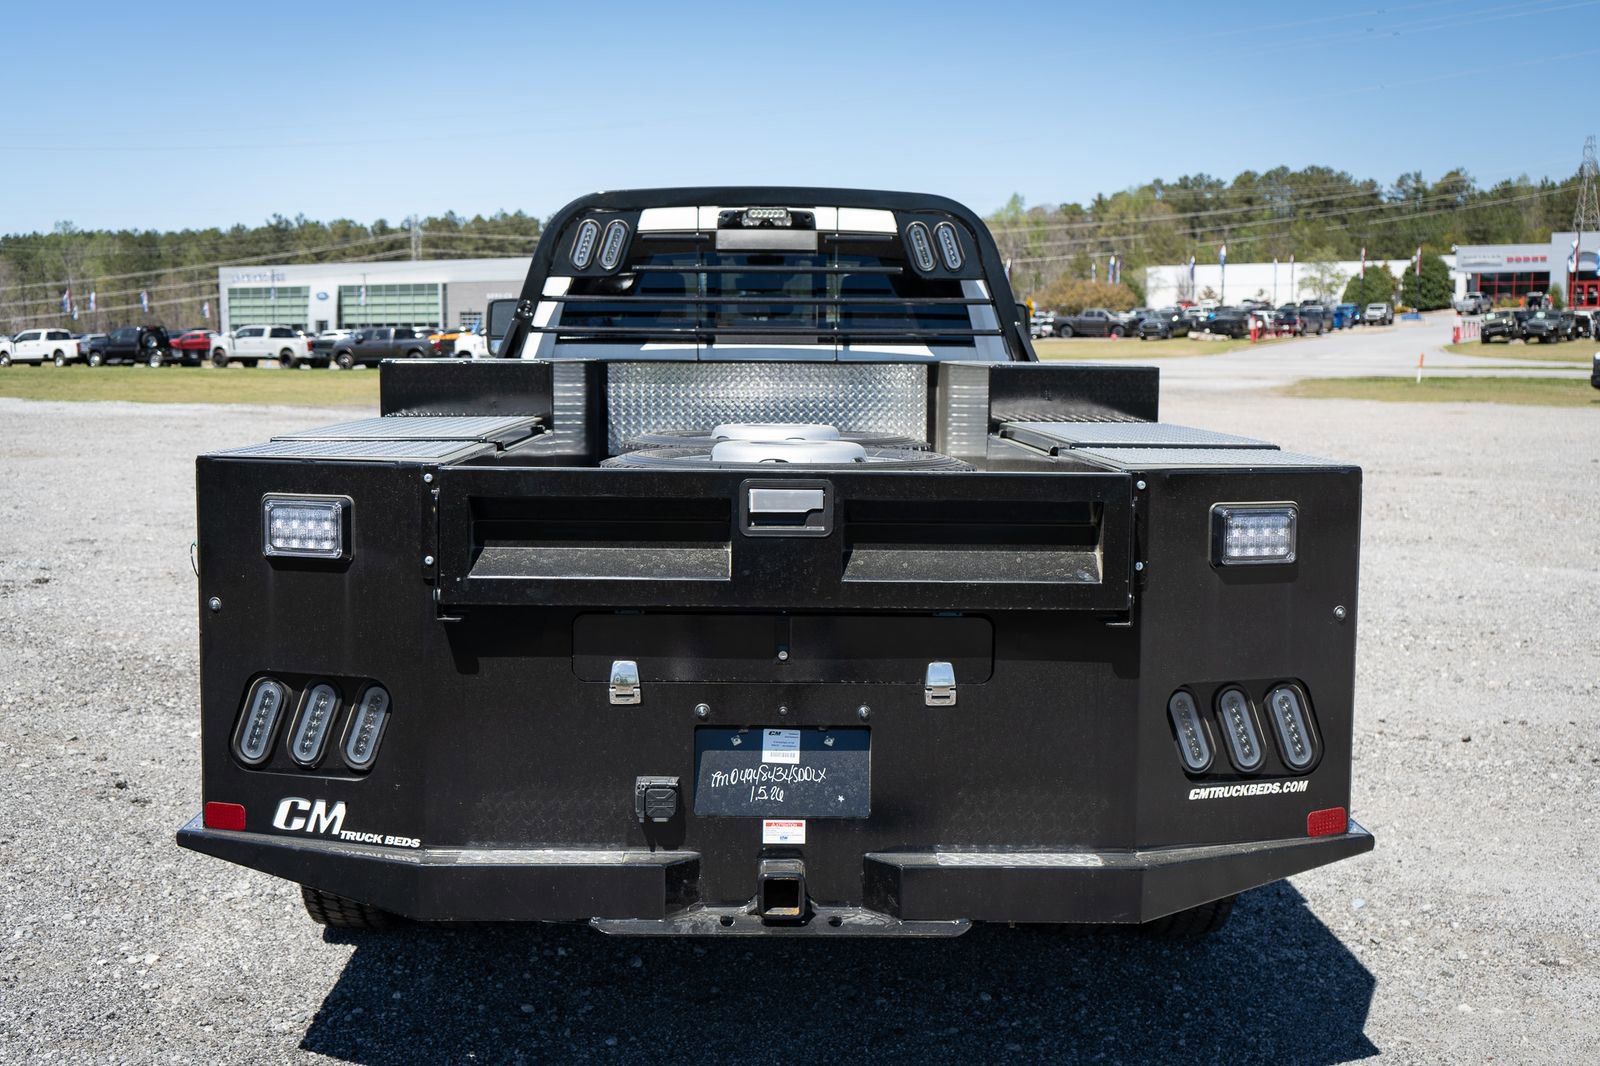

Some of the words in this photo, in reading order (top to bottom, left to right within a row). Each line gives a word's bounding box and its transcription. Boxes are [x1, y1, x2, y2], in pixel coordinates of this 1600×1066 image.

[1188, 780, 1309, 801] CMTRUCKBEDS.COM
[272, 796, 348, 836] CM
[340, 830, 384, 844] TRUCK
[384, 835, 421, 848] BEDS
